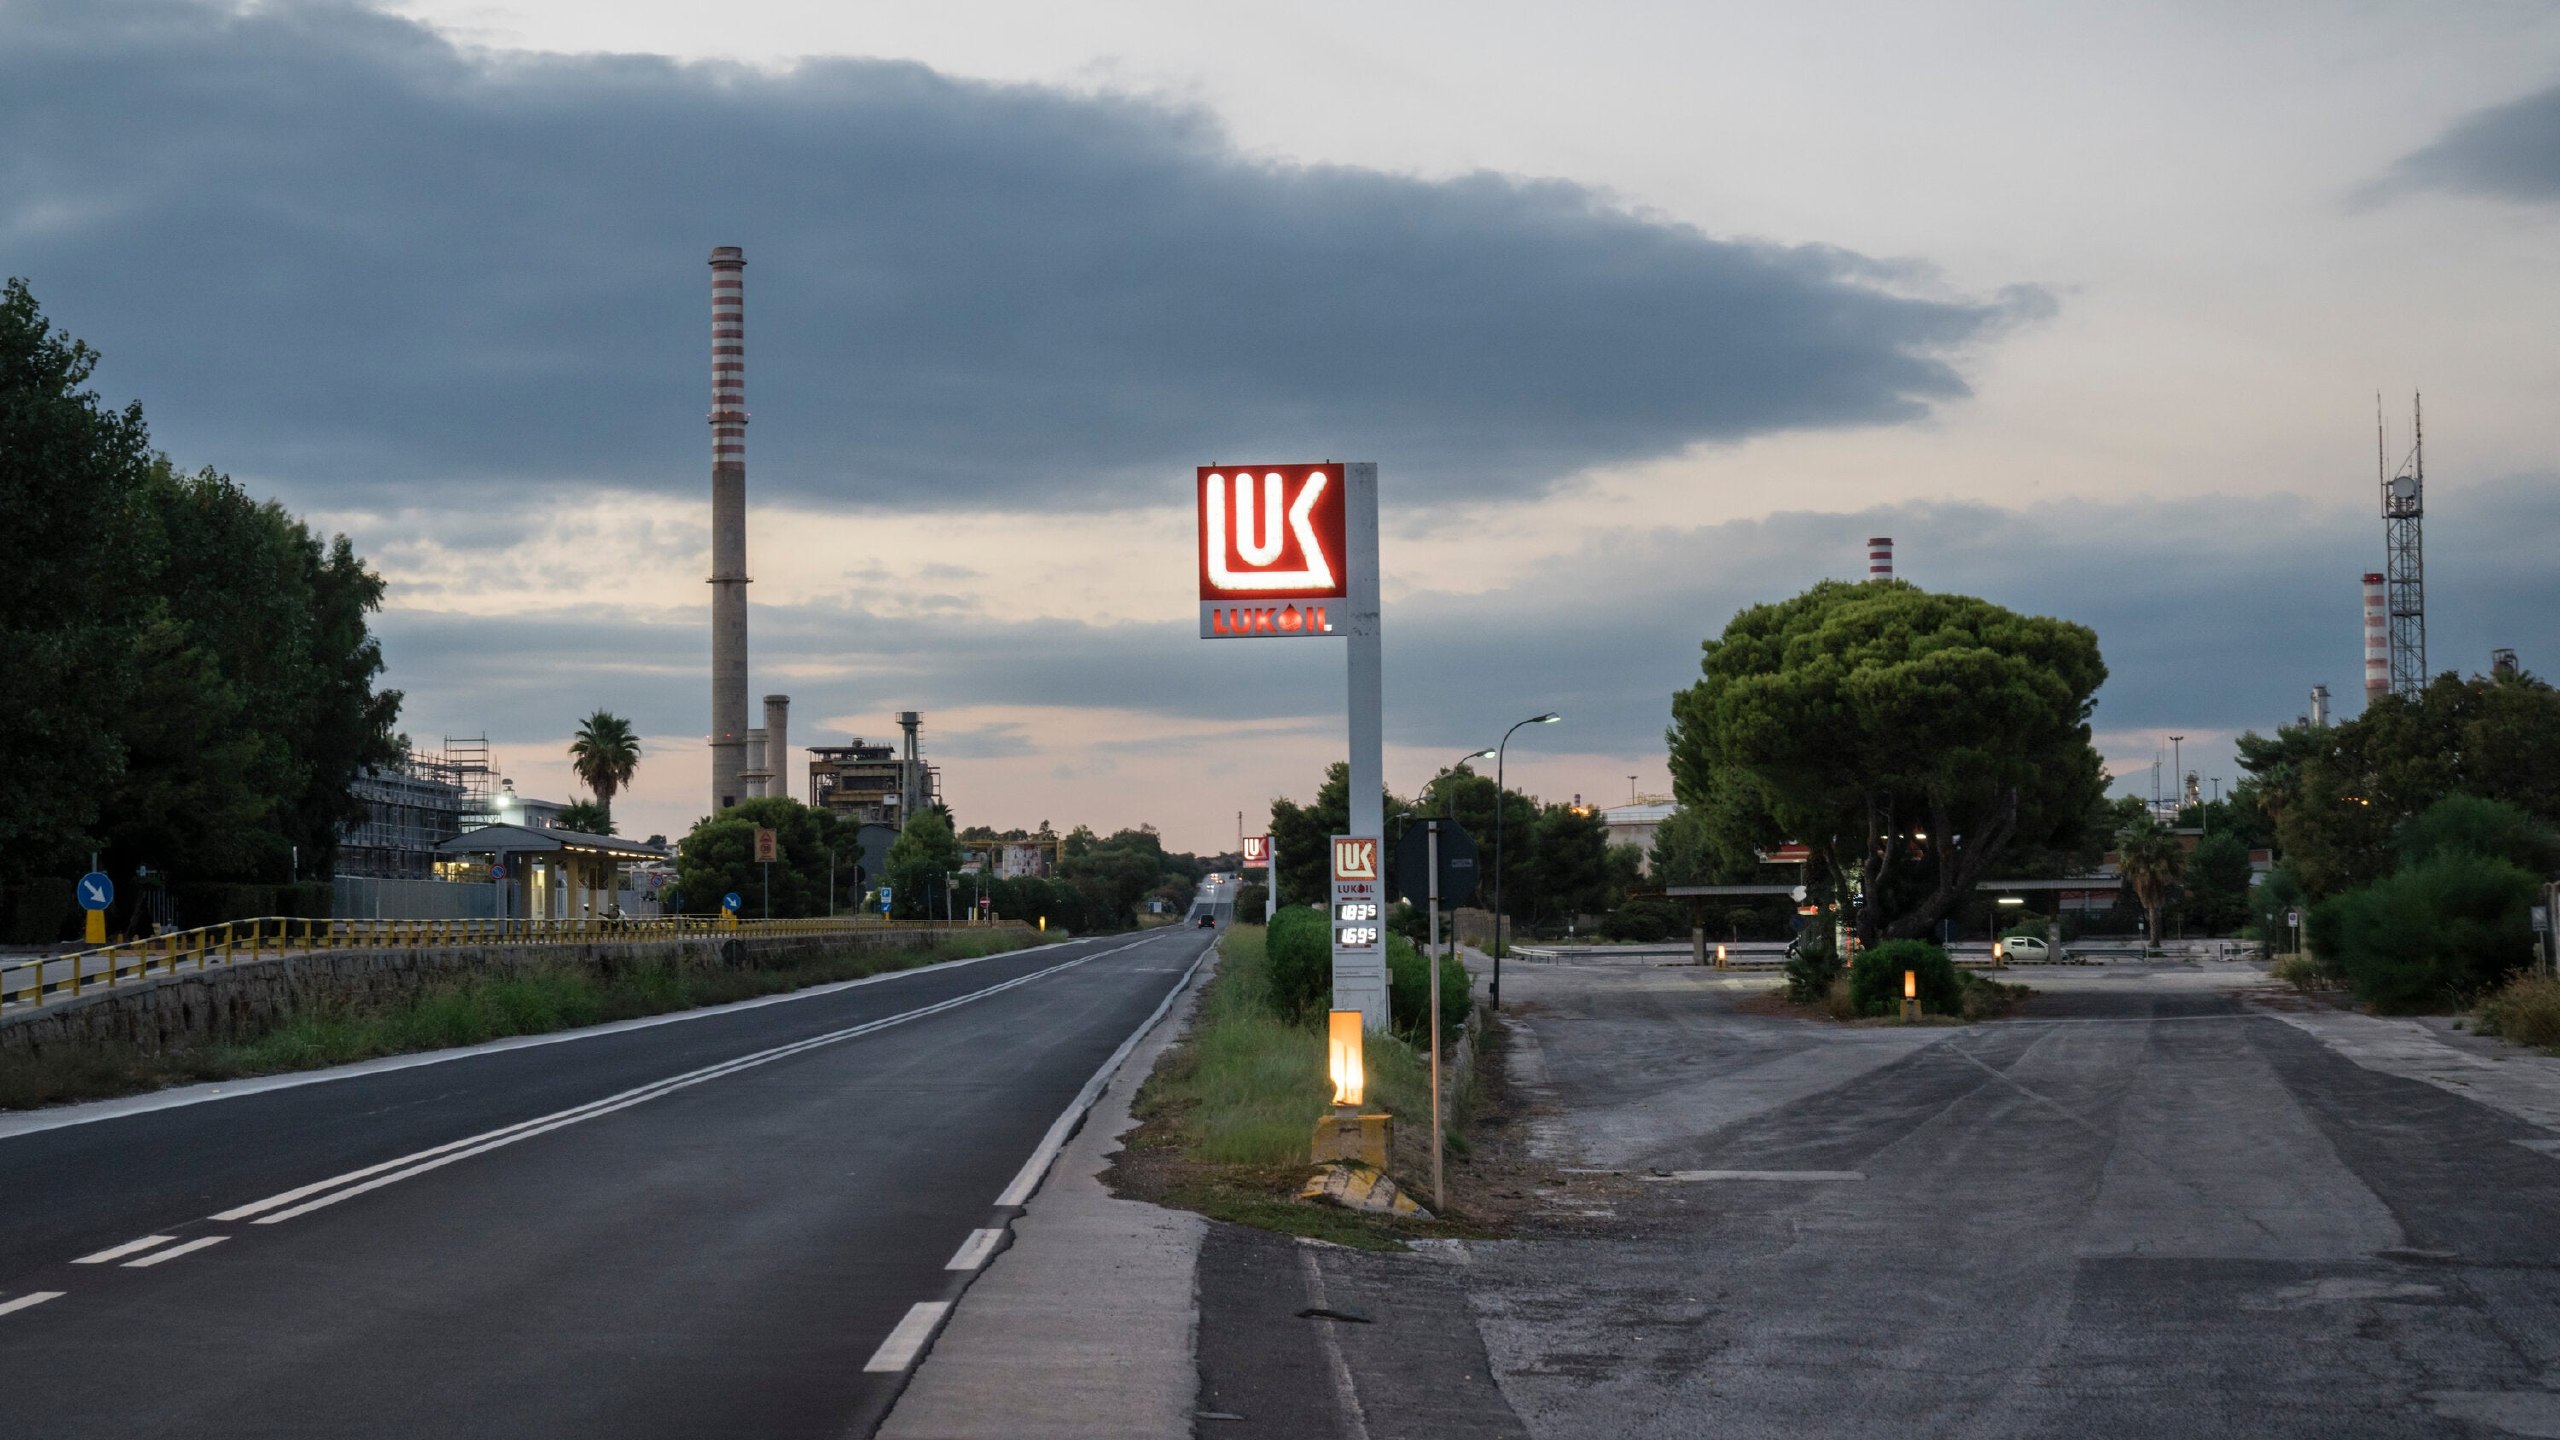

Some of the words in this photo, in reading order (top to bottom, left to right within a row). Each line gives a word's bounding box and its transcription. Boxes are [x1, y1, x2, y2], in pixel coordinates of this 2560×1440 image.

[1207, 471, 1336, 591] LUK
[1213, 603, 1333, 634] LUKOIL
[1244, 838, 1268, 860] LUK
[1336, 842, 1375, 877] LUK
[1337, 883, 1375, 894] LUKOIL
